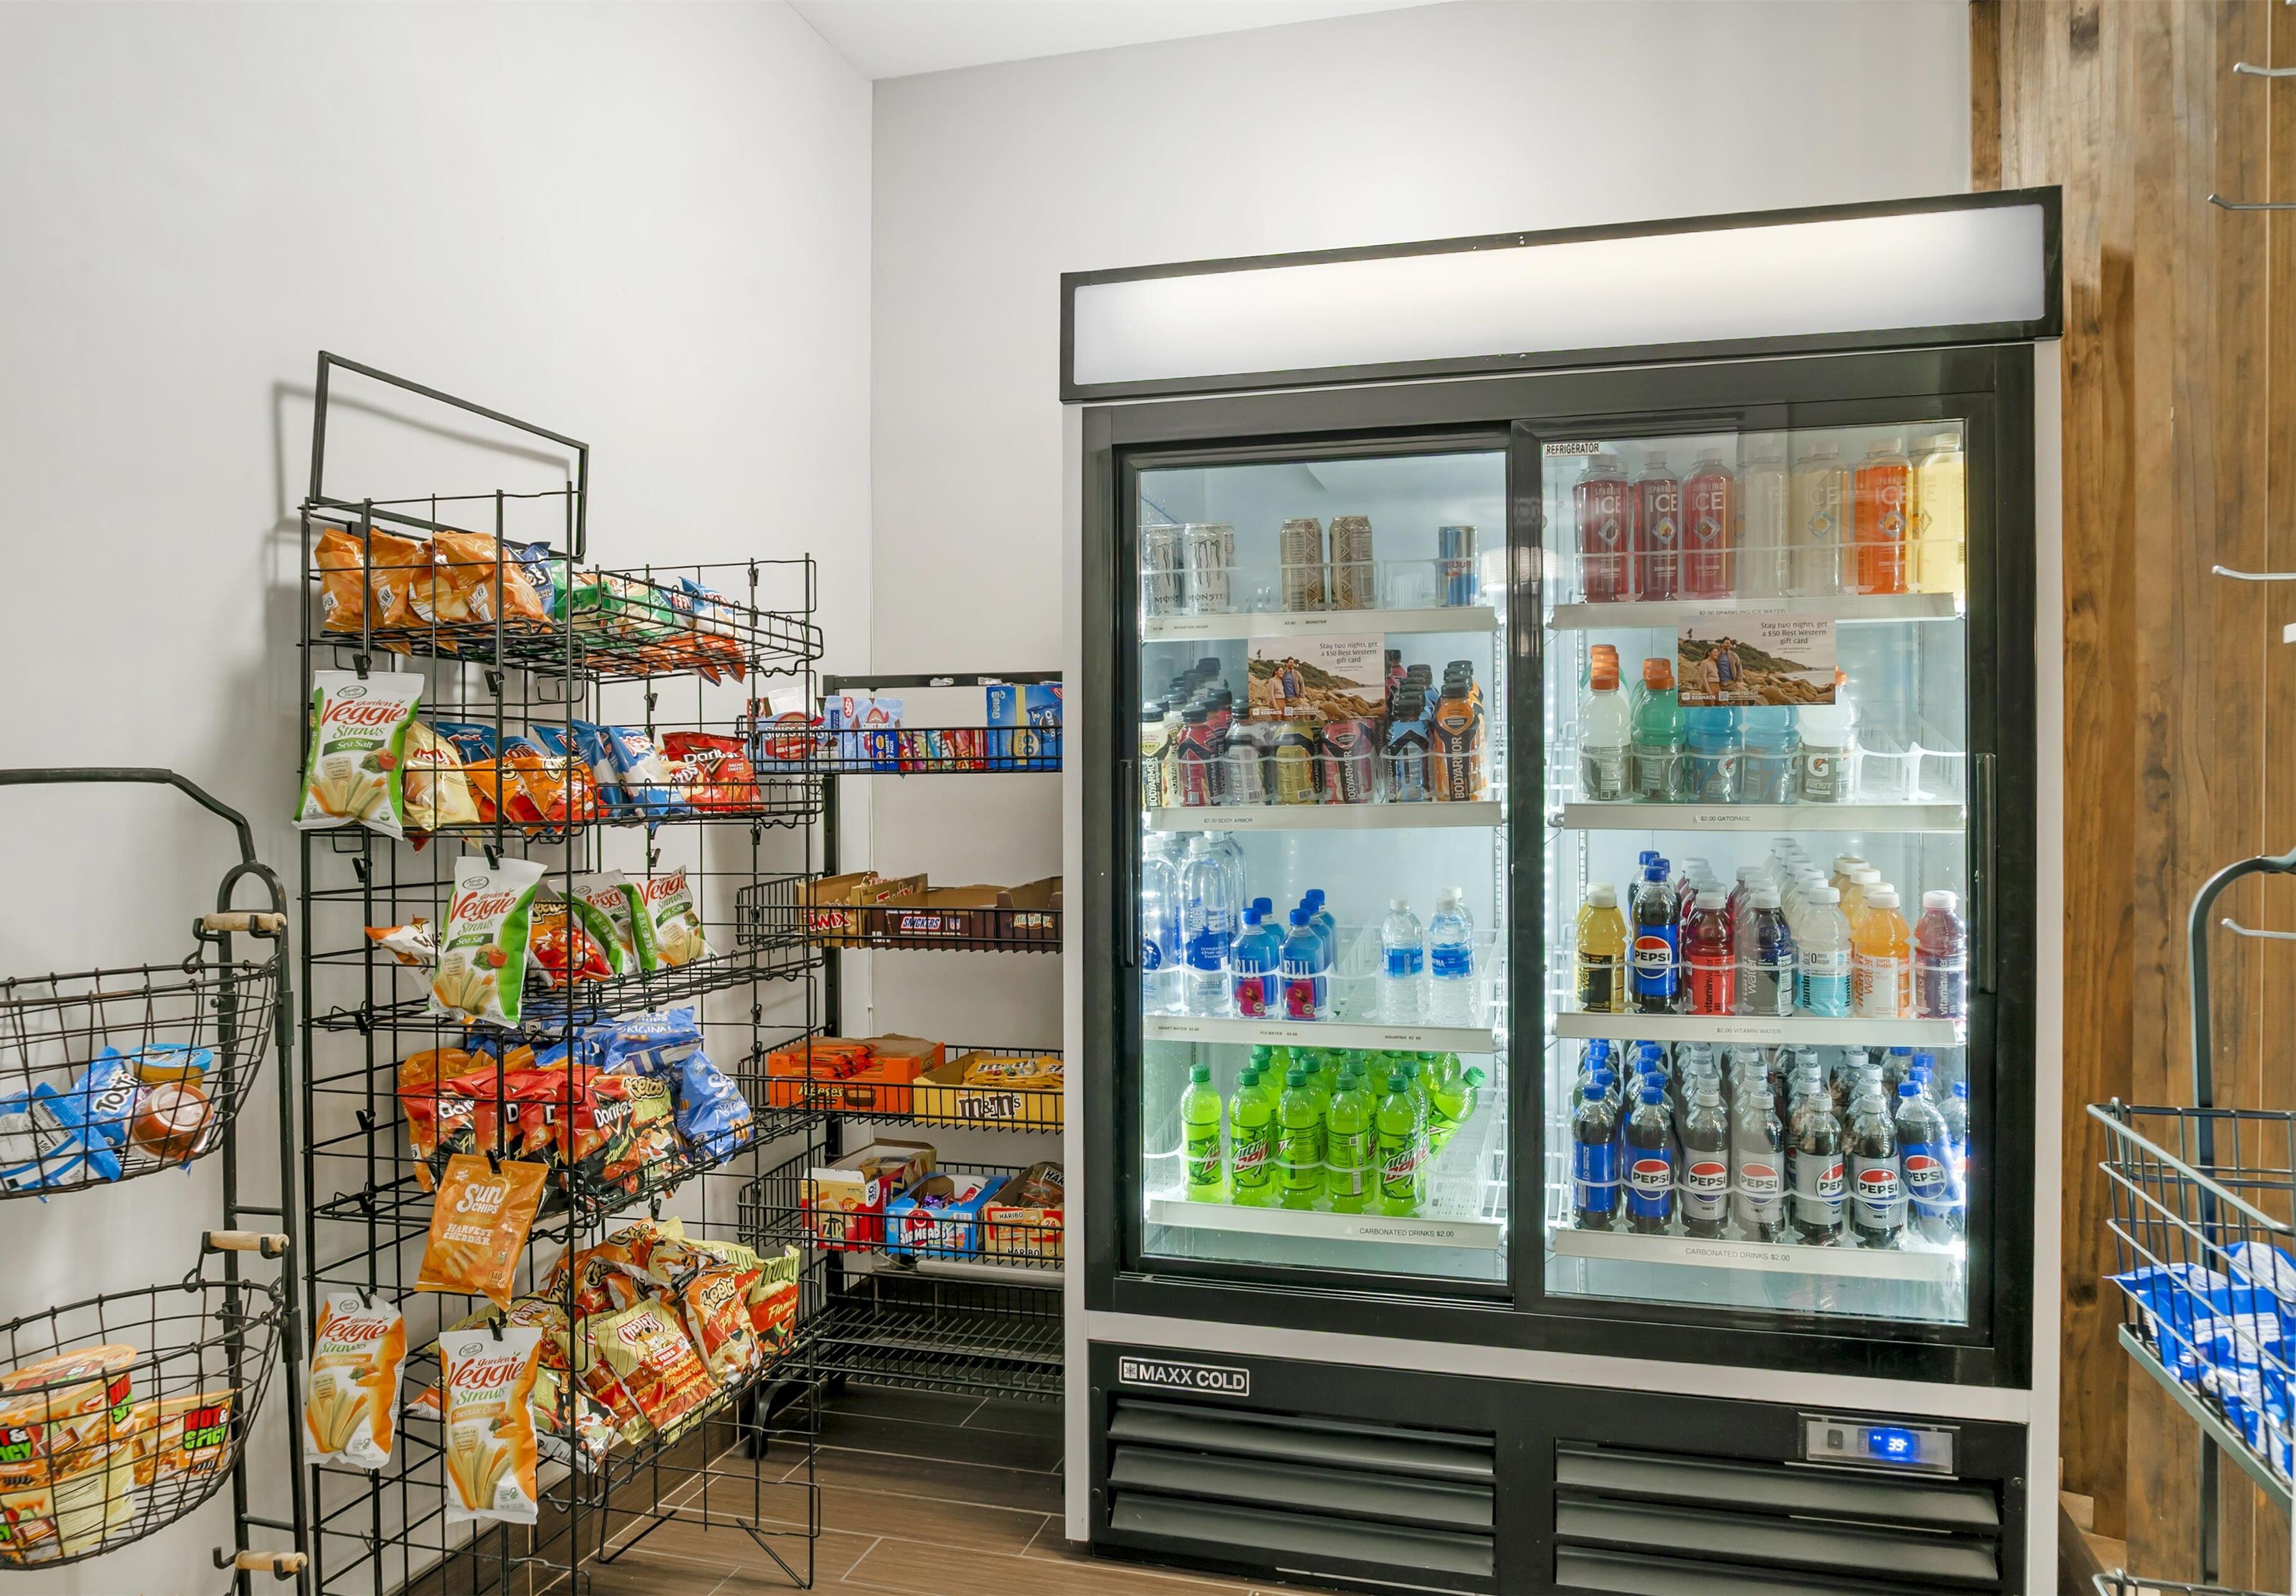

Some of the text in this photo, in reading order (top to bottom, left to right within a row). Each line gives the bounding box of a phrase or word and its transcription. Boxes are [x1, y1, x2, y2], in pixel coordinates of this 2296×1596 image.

[1546, 443, 1599, 455] REFRIGERATOR
[1650, 494, 1677, 512] ICE
[1692, 492, 1723, 510] ICE
[1780, 637, 1792, 645] gift
[355, 699, 393, 707] garden
[844, 700, 853, 714] 50
[321, 698, 408, 727] Veggie
[332, 725, 387, 739] Straws
[336, 739, 373, 749] Sea Salt
[1145, 758, 1158, 807] BODYARMOR
[449, 891, 517, 924] Veggie
[662, 906, 685, 921] Sea Salt
[458, 918, 495, 936] Straws
[456, 936, 484, 946] Sea Salt
[1635, 950, 1670, 962] PEPSI
[38, 1101, 59, 1124] Nutrition
[594, 1100, 633, 1127] Doritos
[1045, 1169, 1065, 1185] HAR
[1633, 1173, 1669, 1184] PEPSI
[1690, 1175, 1726, 1186] PEPSI
[1741, 1175, 1778, 1190] PEPSI
[1908, 1171, 1944, 1182] PEPSI
[1859, 1183, 1898, 1194] PEPSI
[471, 1203, 499, 1214] CHIPS
[447, 1223, 494, 1237] HARVEST
[1359, 1228, 1407, 1237] CARBONATED
[443, 1232, 492, 1246] CHEDDAR
[1008, 1247, 1040, 1256] HARBO
[1685, 1247, 1738, 1257] CARBONATED
[1740, 1252, 1769, 1260] DRINKS
[491, 1271, 503, 1281] 140
[318, 1313, 388, 1343] Veggie
[477, 1356, 509, 1368] garden
[658, 1349, 677, 1362] FRIES
[448, 1358, 525, 1390] Veggie
[1139, 1364, 1245, 1390] MAXX COLD
[457, 1387, 507, 1406] Straws
[452, 1408, 481, 1420] Cheddar
[184, 1425, 227, 1450] SPICY
